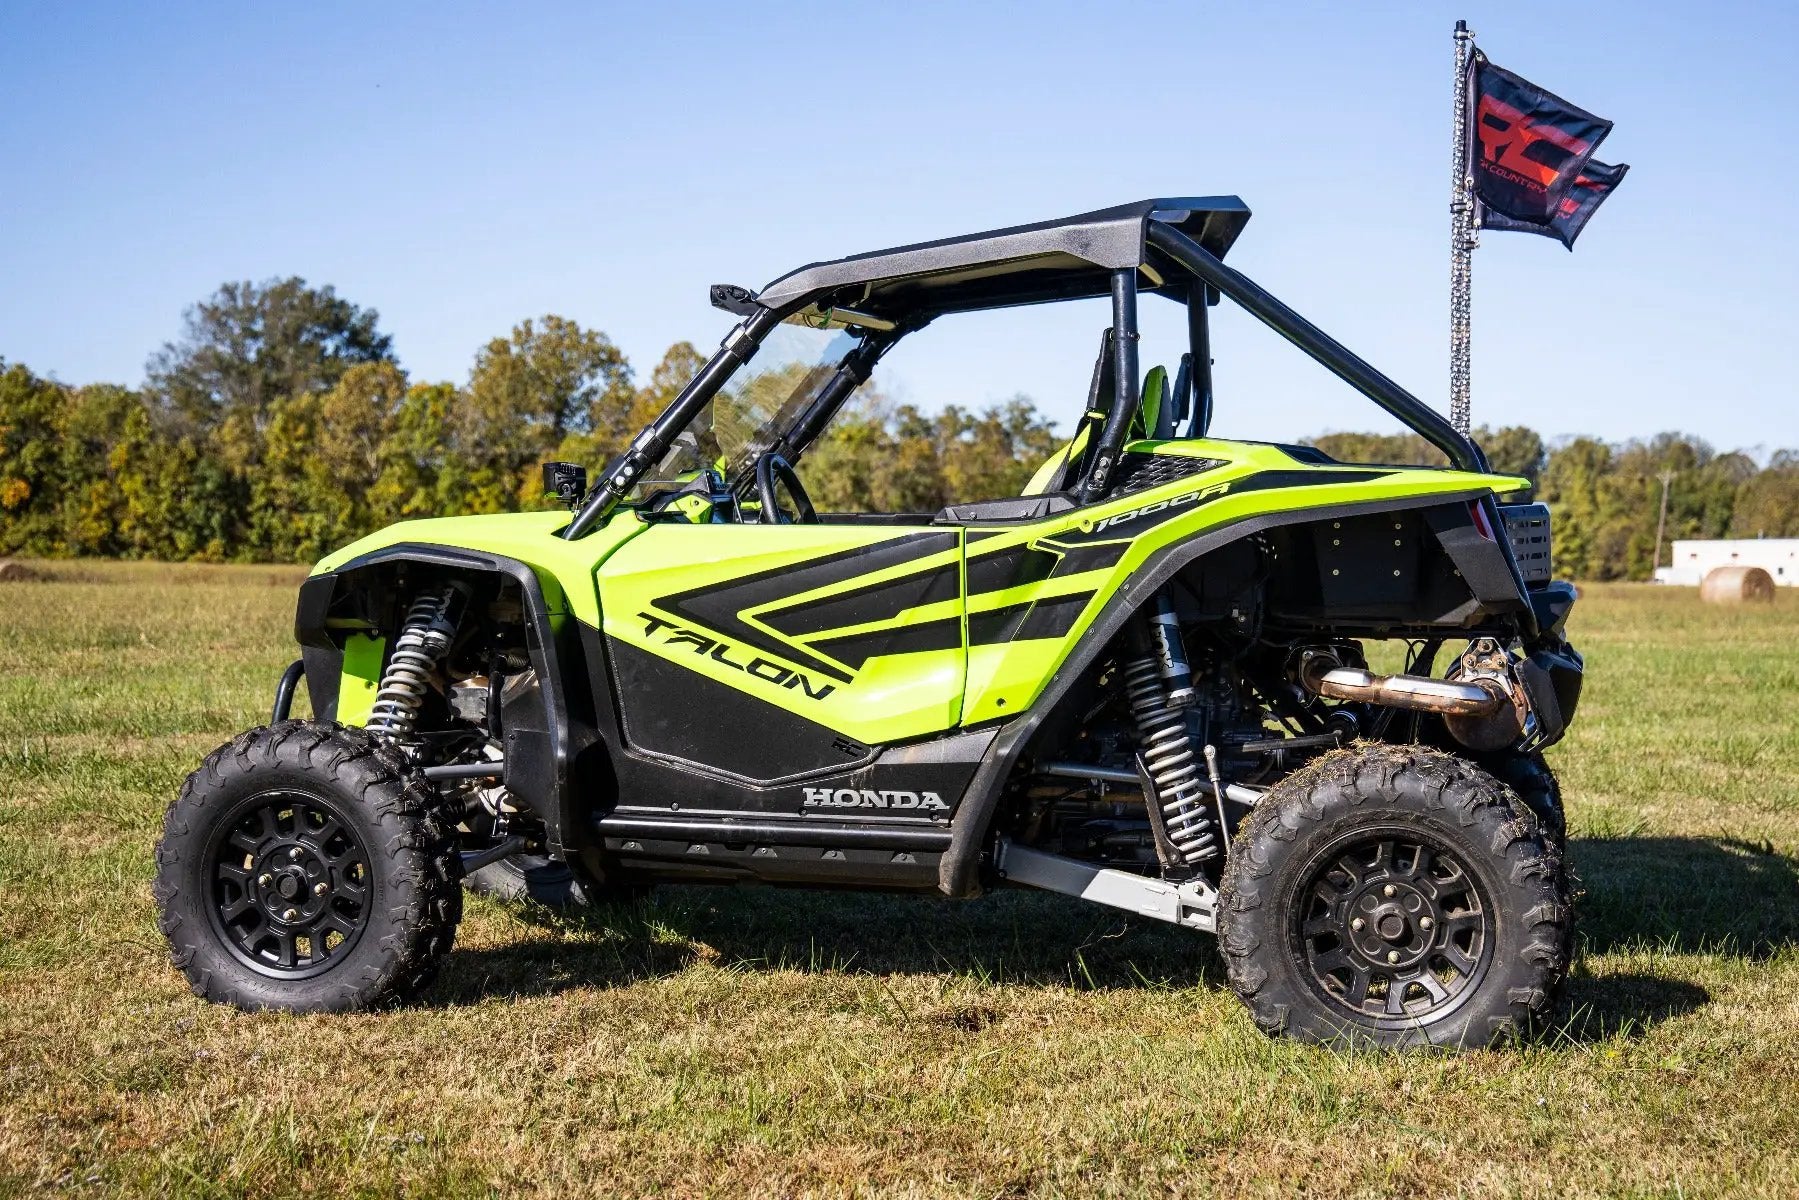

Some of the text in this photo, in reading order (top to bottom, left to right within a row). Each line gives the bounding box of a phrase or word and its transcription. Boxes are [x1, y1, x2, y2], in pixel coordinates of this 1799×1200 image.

[1489, 165, 1548, 193] COUNTRY
[1097, 482, 1231, 532] 1000R
[637, 611, 836, 701] TALON
[802, 787, 949, 811] HONDA
